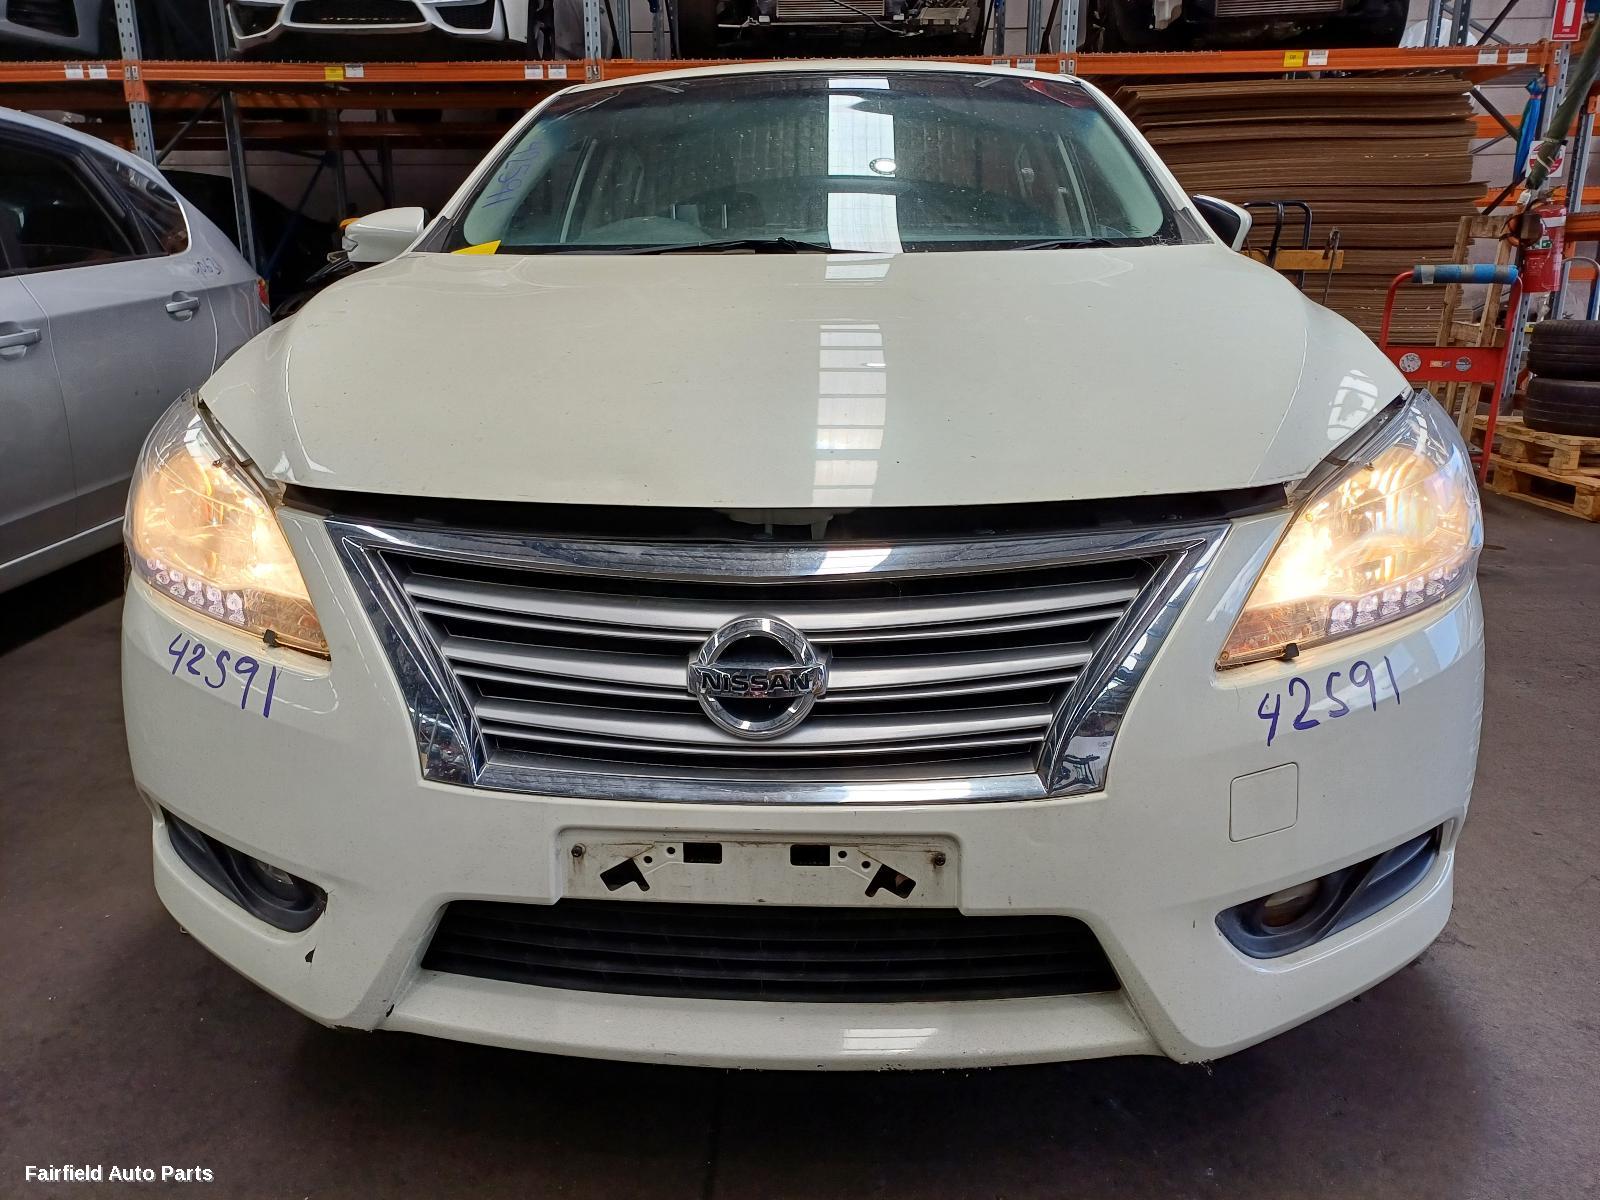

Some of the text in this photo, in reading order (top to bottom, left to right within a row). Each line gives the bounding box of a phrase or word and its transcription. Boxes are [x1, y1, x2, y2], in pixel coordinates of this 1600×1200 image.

[168, 633, 277, 718] 42591
[701, 671, 811, 692] NISSAN
[1257, 656, 1401, 747] 42591
